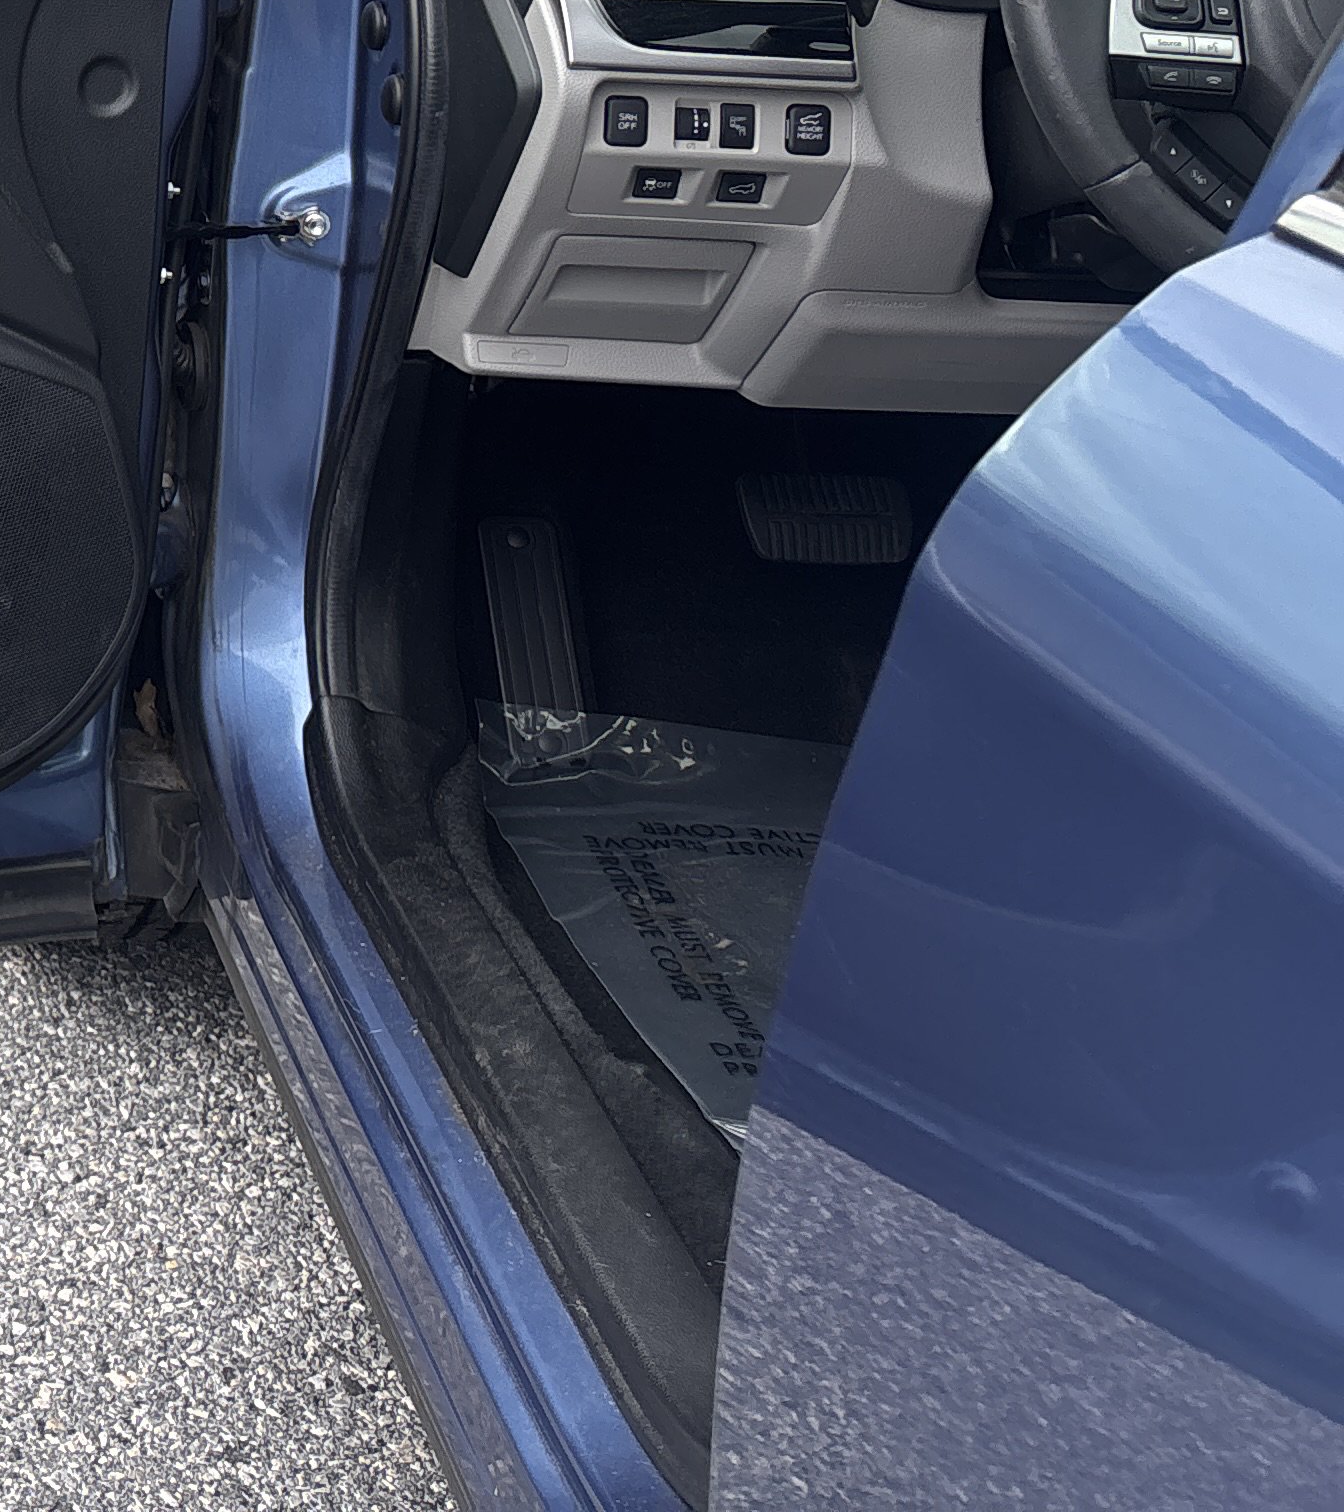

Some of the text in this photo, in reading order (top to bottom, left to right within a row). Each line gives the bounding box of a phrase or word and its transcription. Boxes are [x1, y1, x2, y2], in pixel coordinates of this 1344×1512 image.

[1157, 38, 1182, 47] Source
[617, 121, 638, 130] OFF
[656, 181, 673, 189] OFF
[637, 821, 736, 839] COVER
[649, 945, 703, 1001] COVER
